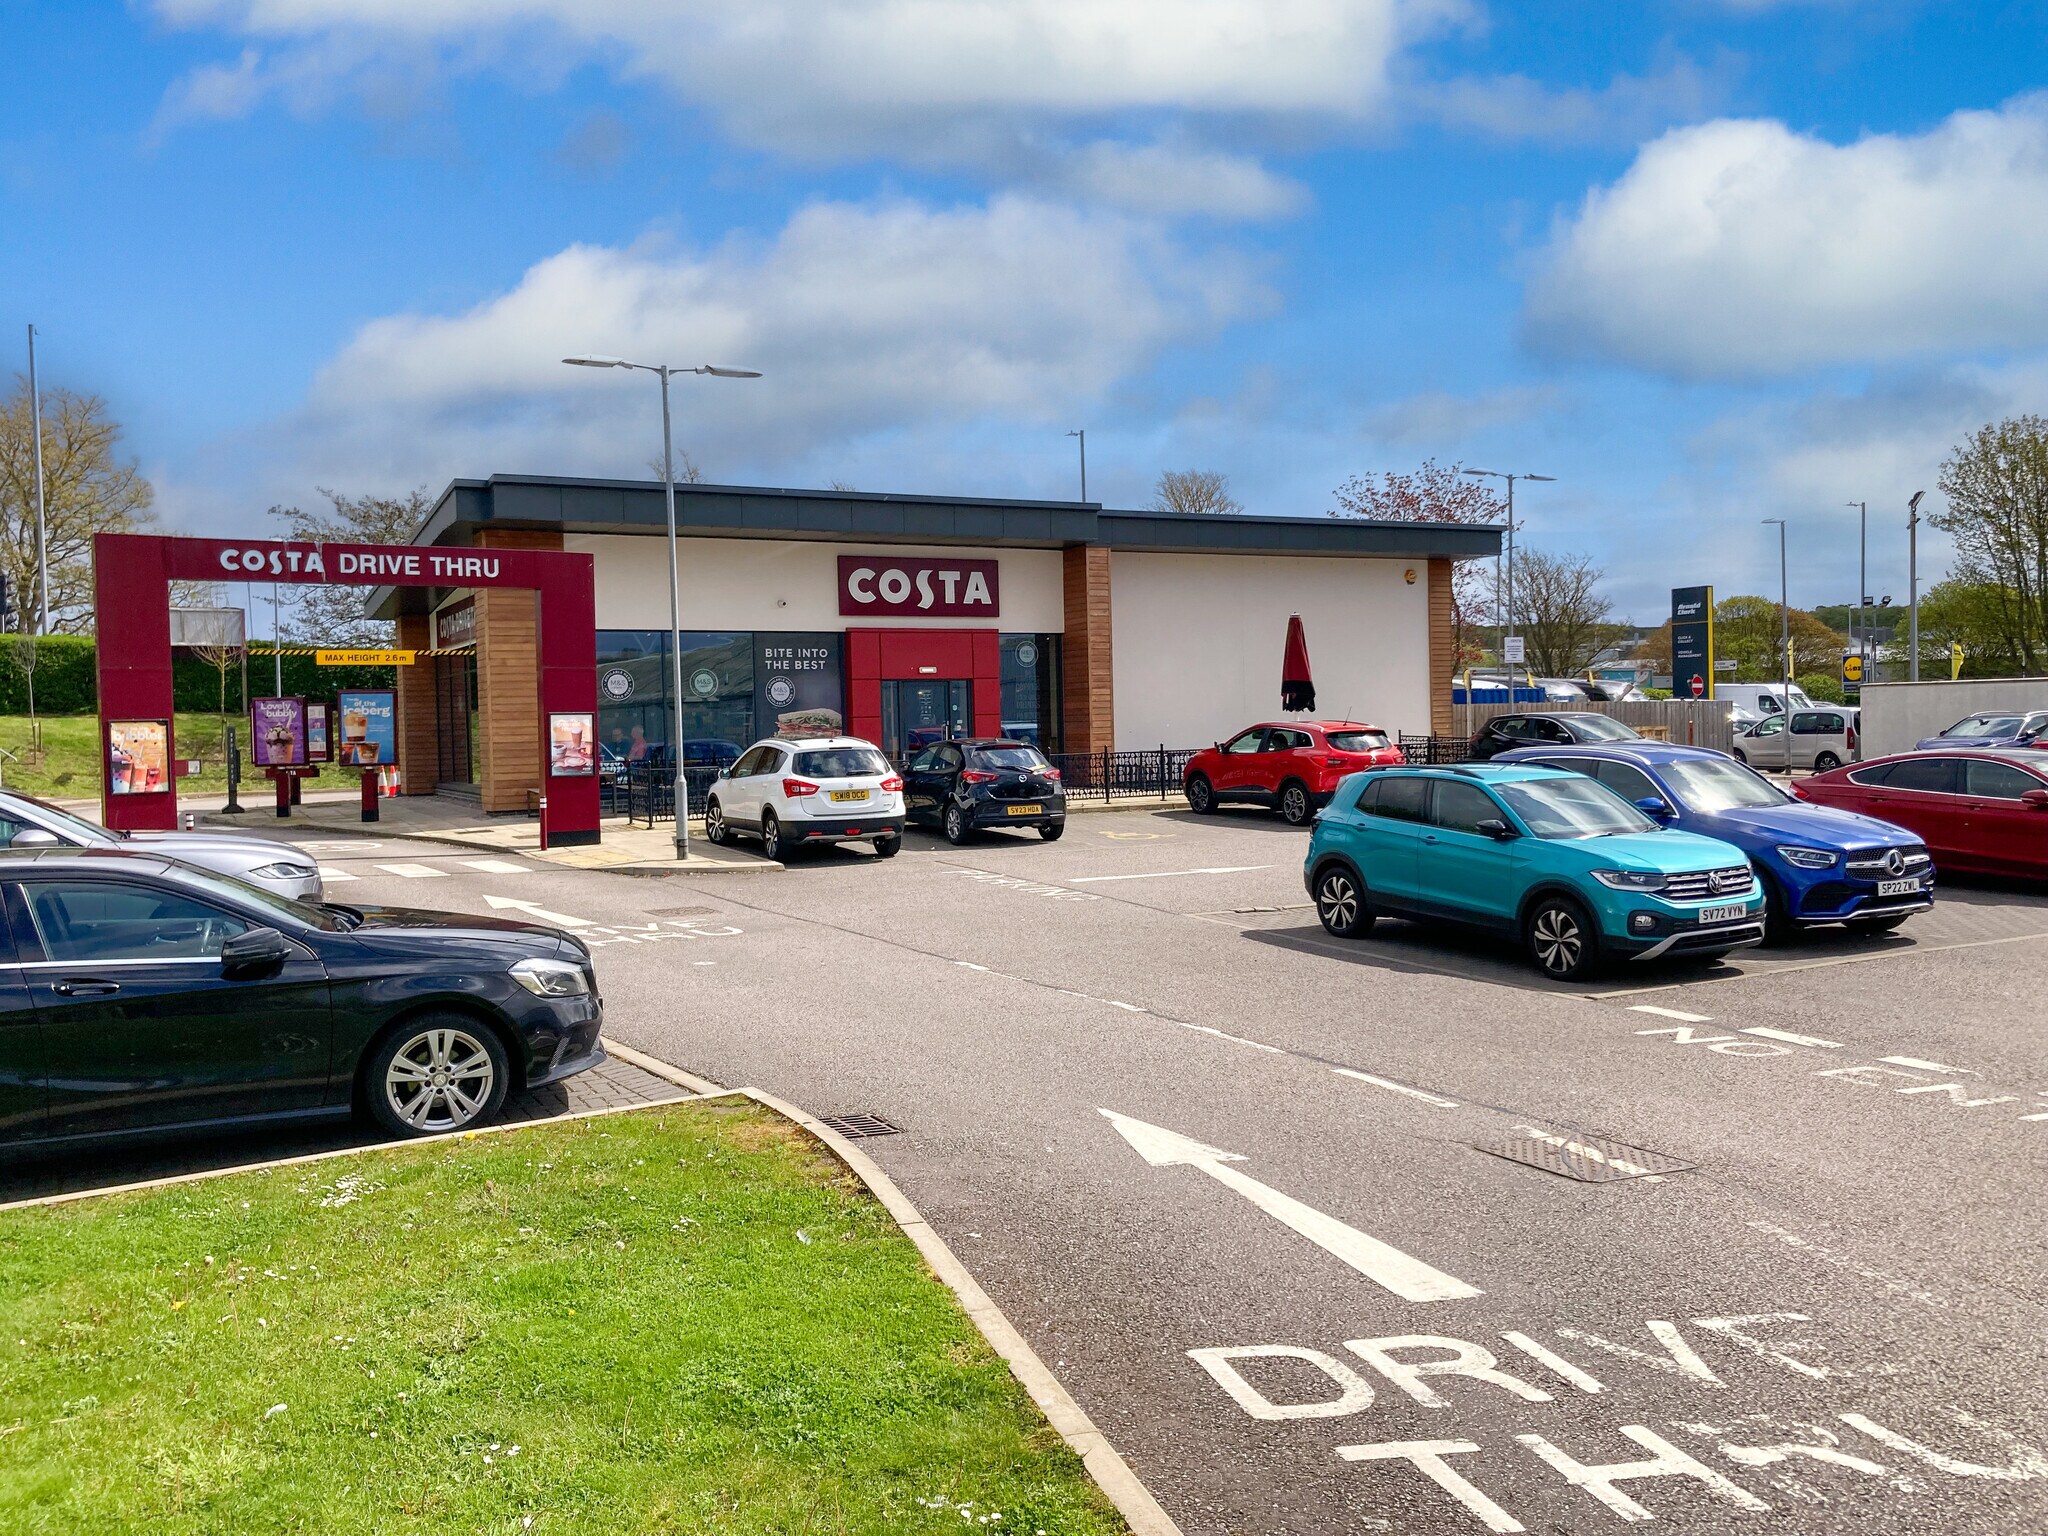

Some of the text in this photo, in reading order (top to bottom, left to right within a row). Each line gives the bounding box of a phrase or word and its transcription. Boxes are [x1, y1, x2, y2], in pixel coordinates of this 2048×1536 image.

[219, 548, 500, 578] COSTA DRIVE THRU
[847, 567, 993, 610] COSTA
[347, 654, 380, 662] HEIGHT
[765, 648, 828, 658] BITE INTO
[765, 660, 826, 670] THE BEST
[610, 679, 626, 687] M&S
[260, 702, 291, 711] Lovely
[344, 705, 391, 717] iceberg
[266, 709, 298, 718] bubbly
[1882, 880, 1917, 894] SP22 ZWL
[1702, 904, 1743, 920] SV72 VYN
[1633, 1026, 1793, 1057] NO
[1186, 1313, 1890, 1421] DRIVE
[1333, 1404, 2048, 1534] THRU
